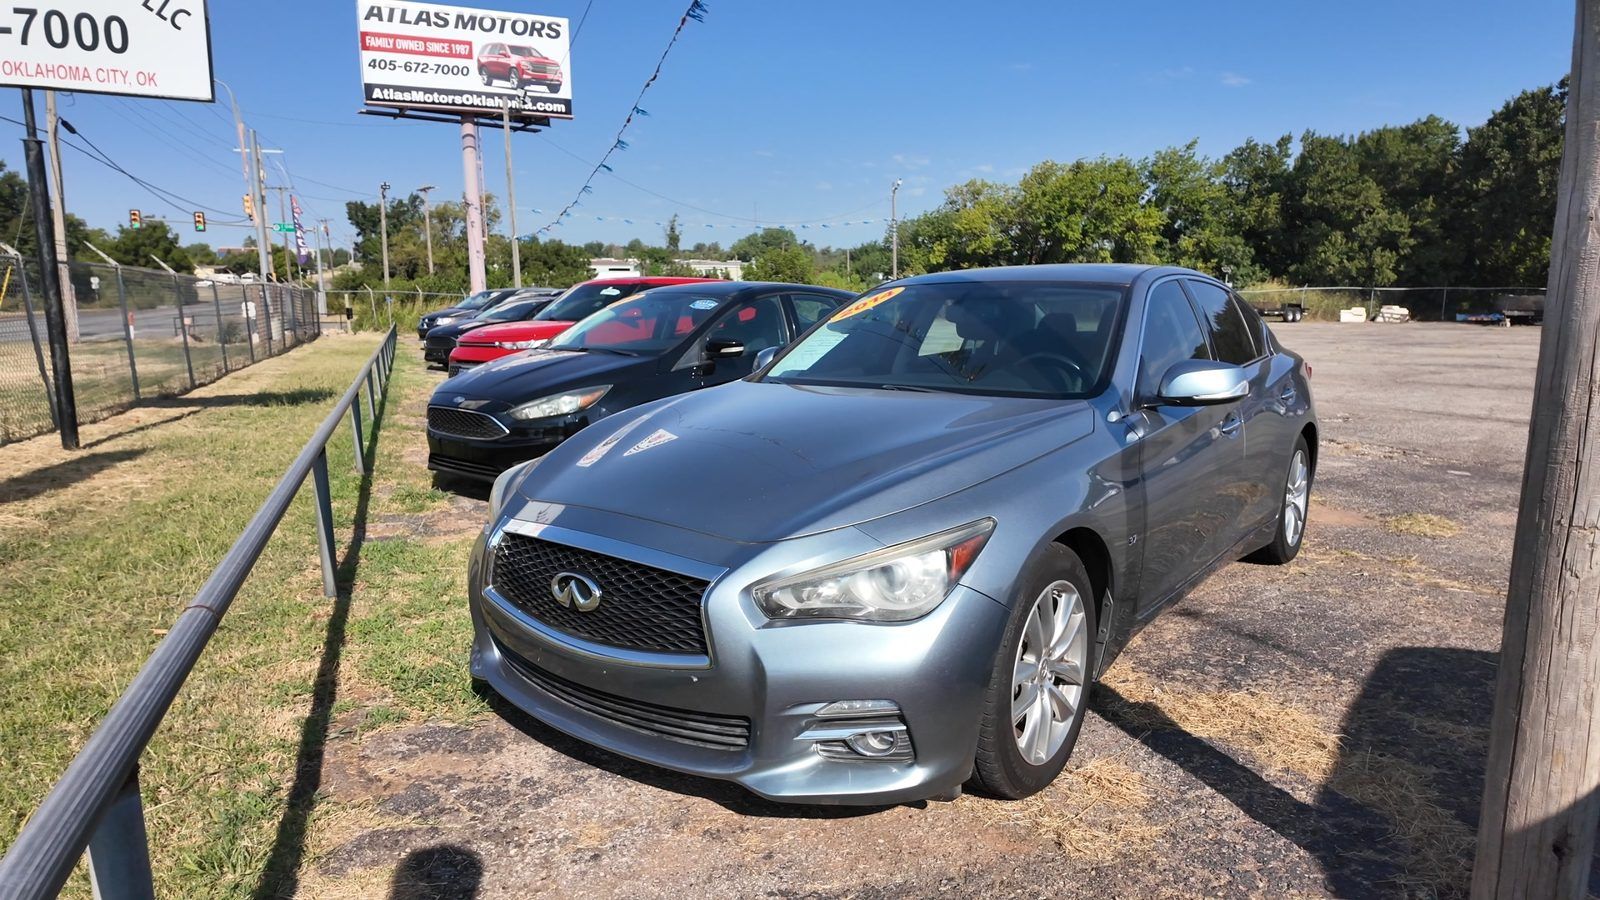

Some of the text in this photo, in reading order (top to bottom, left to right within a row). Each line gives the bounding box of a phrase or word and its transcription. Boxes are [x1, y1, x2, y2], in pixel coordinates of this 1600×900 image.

[364, 5, 562, 39] ATLAS MOTORS
[365, 36, 470, 55] FAMILY OWNED SINCE 1987
[2, 60, 158, 87] OKLAHOMA CITY, OK
[368, 58, 470, 77] 405-672-7000
